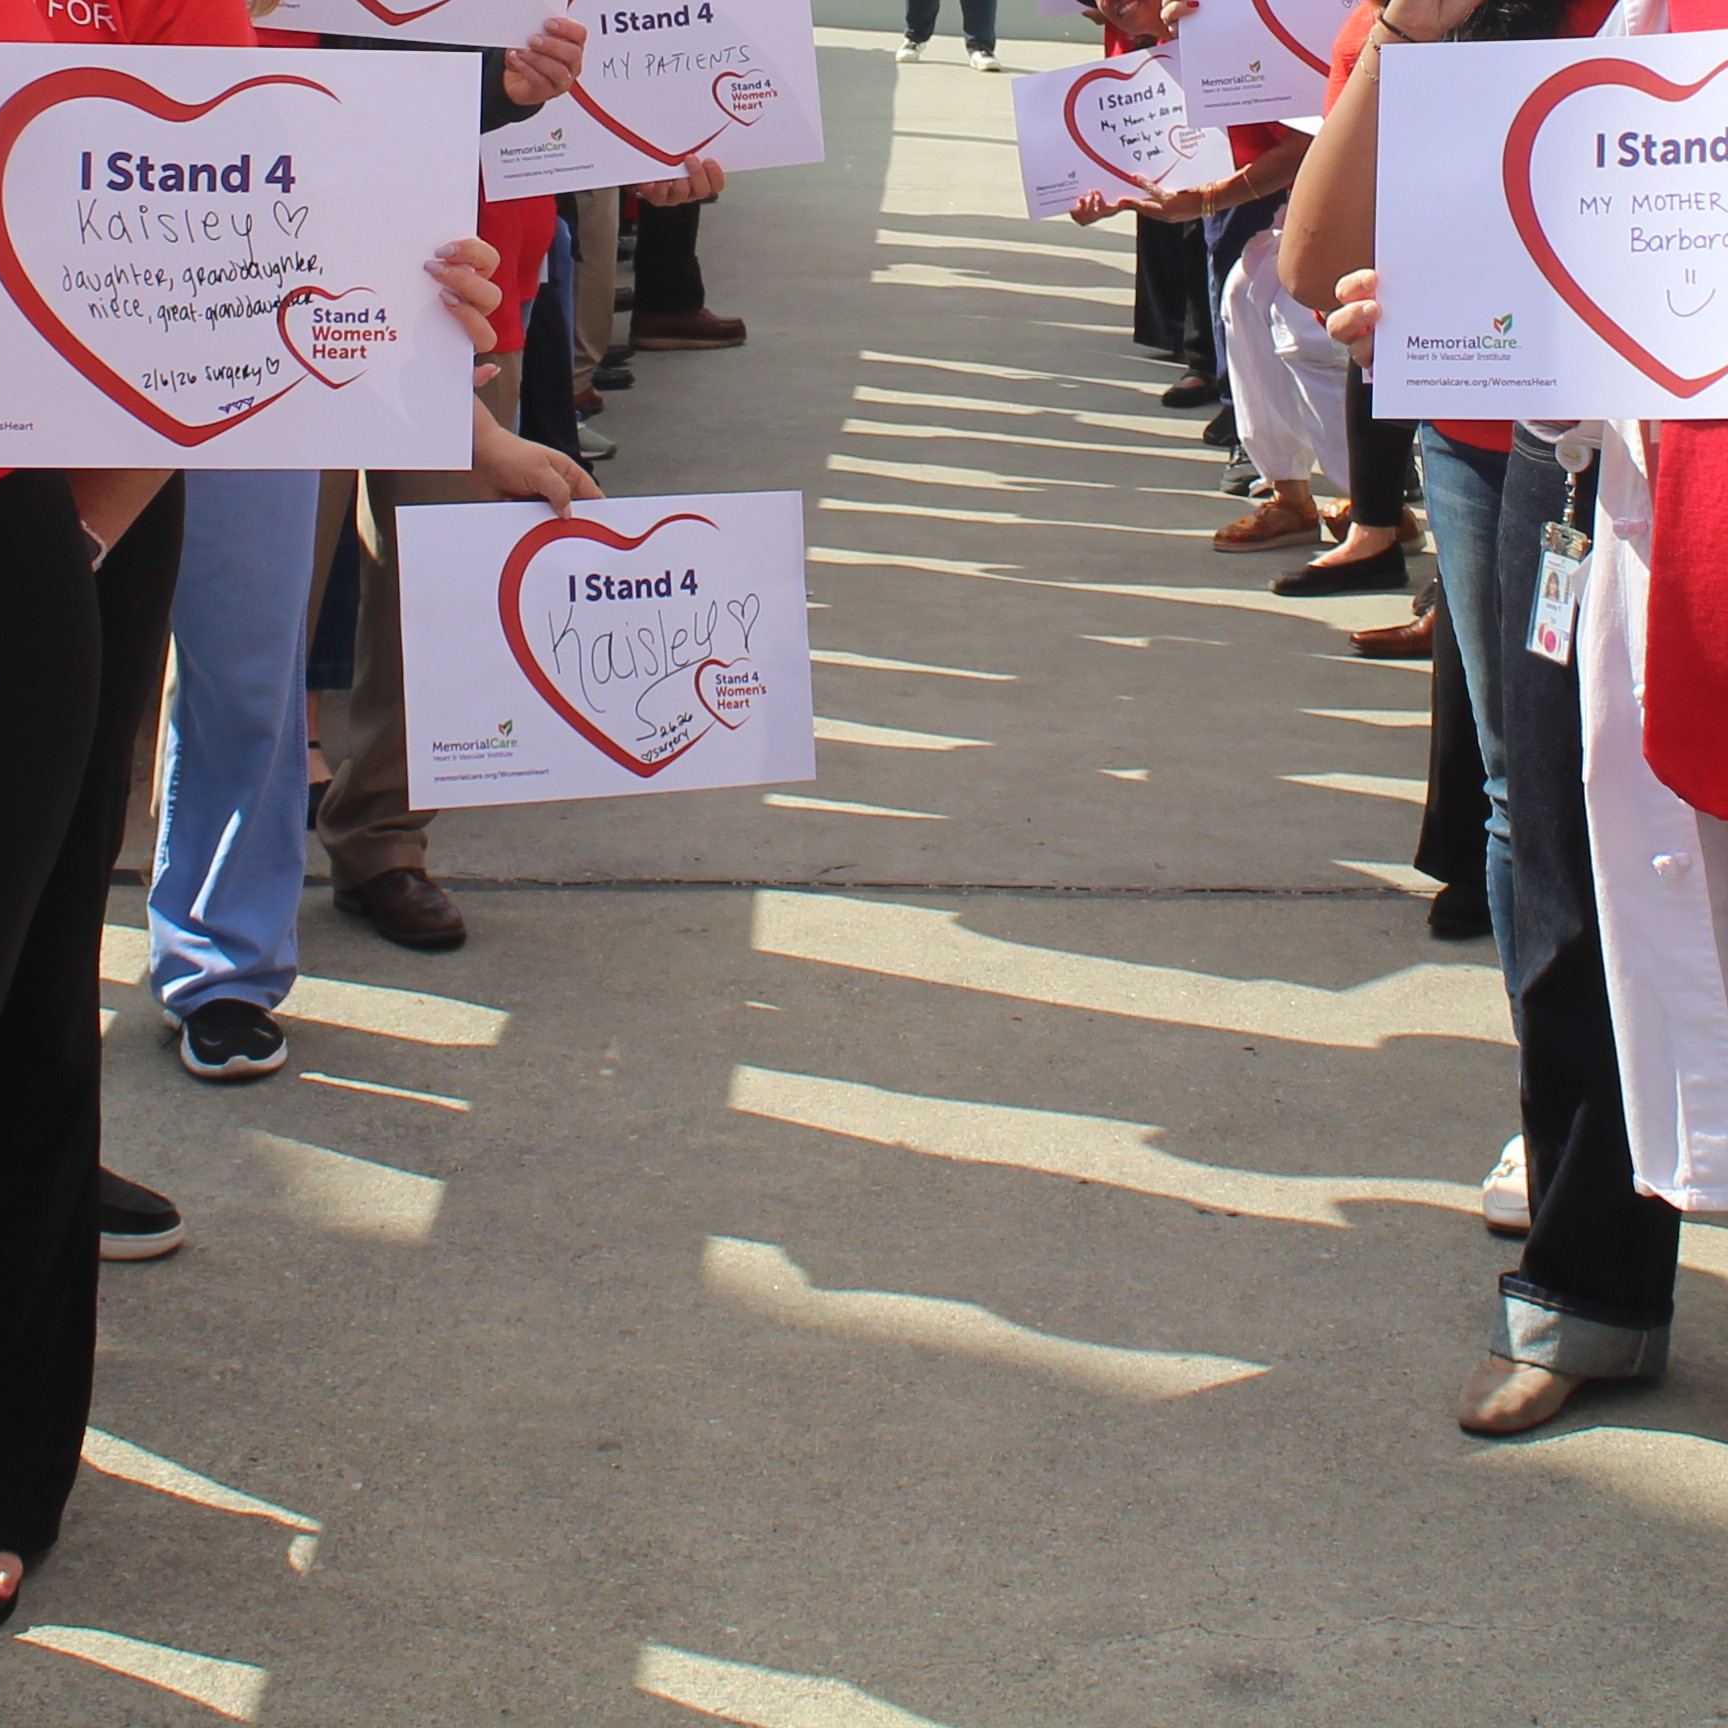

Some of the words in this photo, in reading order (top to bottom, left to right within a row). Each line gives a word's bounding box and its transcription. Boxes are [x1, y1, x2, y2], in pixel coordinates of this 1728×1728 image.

[600, 14, 608, 35] I
[614, 5, 691, 34] Stand
[697, 2, 714, 24] 4
[602, 51, 630, 80] MY
[644, 44, 751, 77] PATIENTS
[731, 79, 762, 92] Stand
[763, 79, 771, 89] 4
[1201, 74, 1265, 87] MemorialCare
[731, 88, 778, 102] Women's
[1098, 97, 1104, 111] I
[1107, 87, 1154, 109] Stand
[1156, 82, 1166, 97] 4
[733, 101, 764, 112] Heart
[500, 142, 568, 157] MemorialCare
[1596, 133, 1606, 168] I
[80, 151, 92, 191] I
[106, 152, 251, 193] Stand
[264, 155, 296, 193] 4
[1579, 195, 1612, 215] MY
[1631, 192, 1728, 215] MOTHER
[77, 198, 254, 262] Kaisley
[62, 263, 174, 301] daughter,
[312, 308, 369, 324] Stand
[374, 308, 387, 323] 4
[312, 325, 397, 342] Women's
[1407, 335, 1518, 349] MemorialCare
[312, 344, 368, 360] Heart
[1407, 352, 1429, 361] Heart
[1431, 352, 1437, 361] &
[1440, 352, 1474, 361] Vascular
[1477, 352, 1511, 361] Institute
[142, 368, 197, 393] 2/6/26
[1406, 377, 1557, 388] memorialcare.org/WomensHeart
[568, 575, 577, 602] I
[585, 570, 673, 602] Stand
[680, 568, 698, 596] 4
[548, 600, 718, 741] Kaisley
[715, 672, 749, 686] Stand
[751, 672, 759, 683] 4
[715, 683, 767, 697] Women's
[716, 698, 750, 711] Heart
[432, 737, 518, 752] MemorialCare
